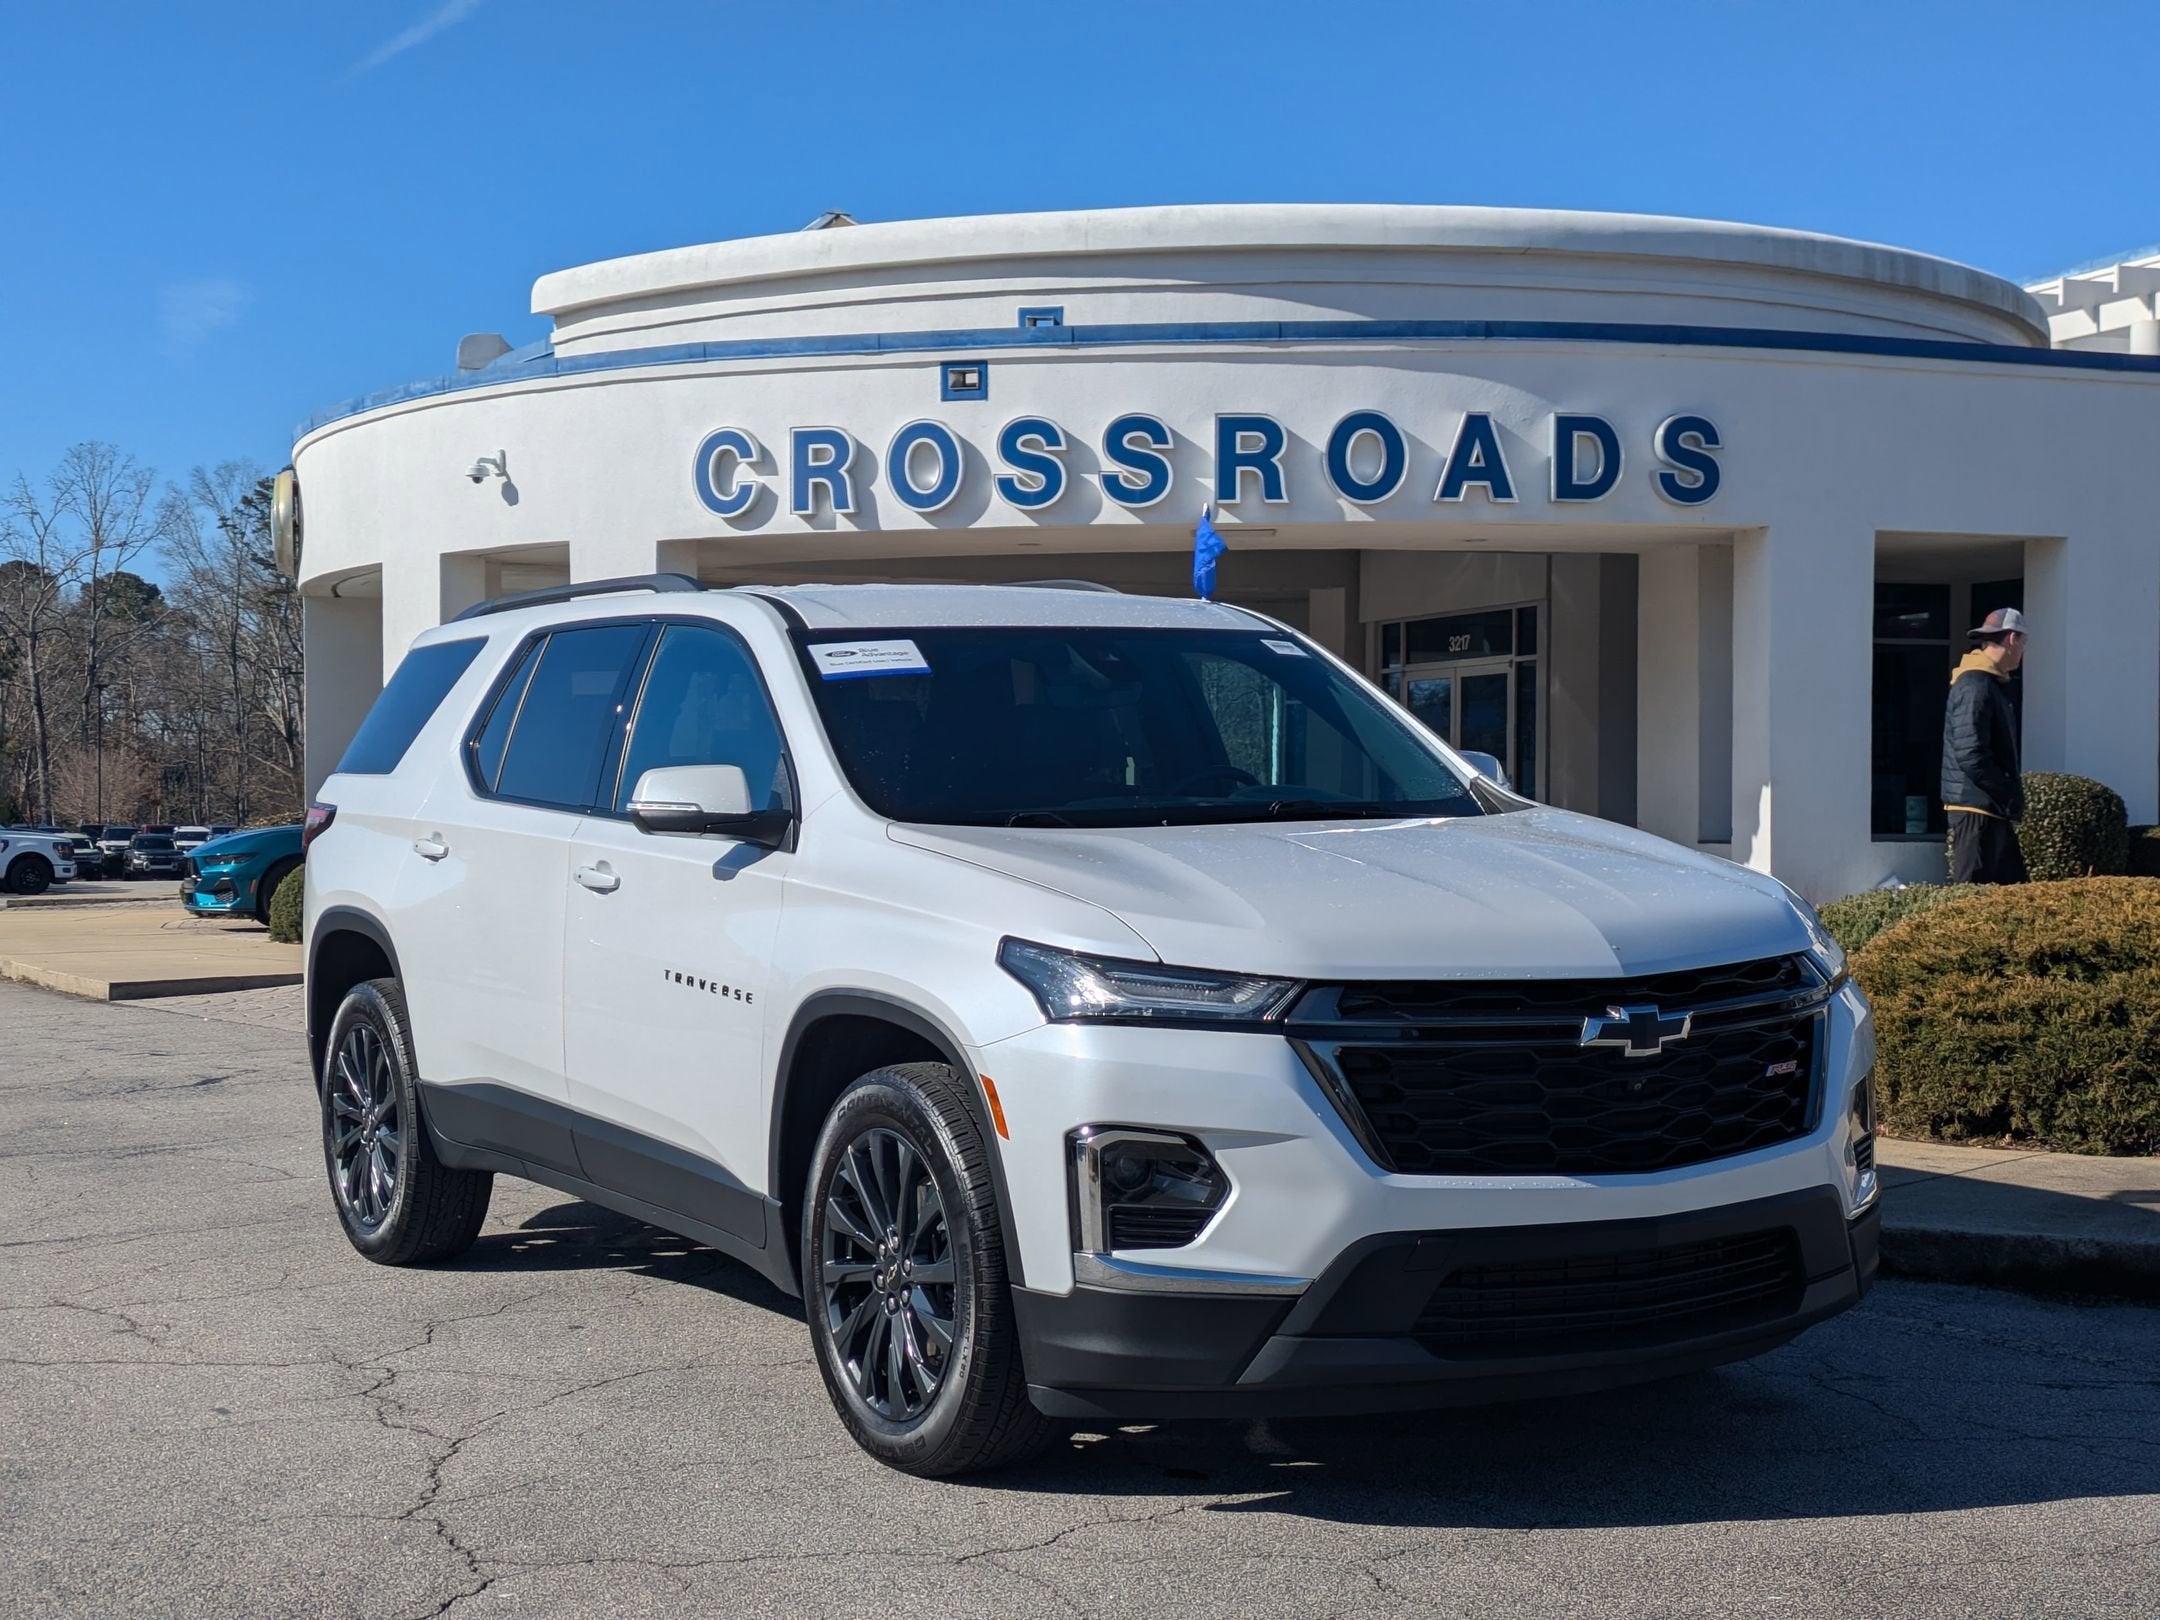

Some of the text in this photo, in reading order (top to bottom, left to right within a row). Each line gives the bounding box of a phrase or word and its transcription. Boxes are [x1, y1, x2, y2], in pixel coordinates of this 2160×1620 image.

[693, 408, 1723, 518] CROSSROADS
[1448, 634, 1471, 652] 3217
[664, 969, 753, 1005] TRAVERSE
